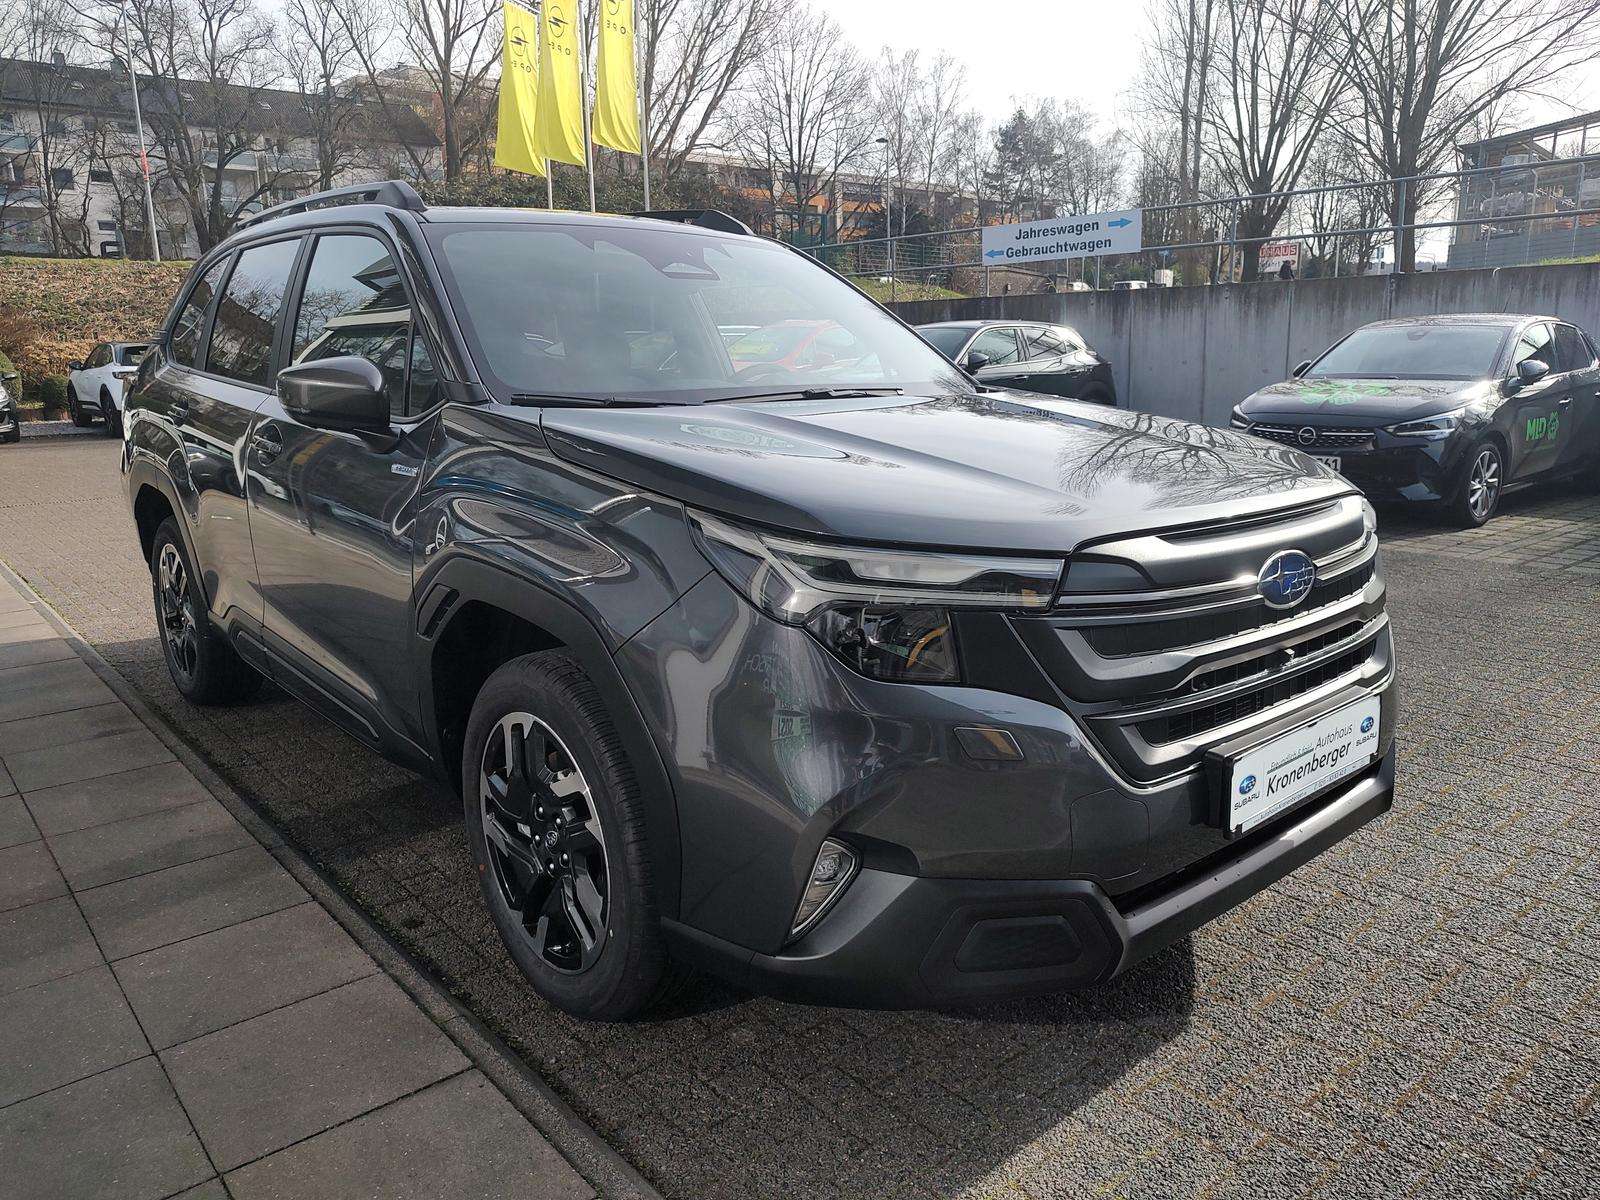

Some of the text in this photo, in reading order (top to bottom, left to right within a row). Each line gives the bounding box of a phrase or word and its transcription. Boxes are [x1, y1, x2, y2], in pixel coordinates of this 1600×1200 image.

[1015, 221, 1099, 240] Jahreswagen
[1006, 238, 1112, 258] Gebrauchtwagen
[1315, 723, 1353, 750] Autohaus
[1356, 732, 1377, 747] SUBARU
[1266, 742, 1351, 796] Kronenberger
[1234, 792, 1260, 811] SUBARU
